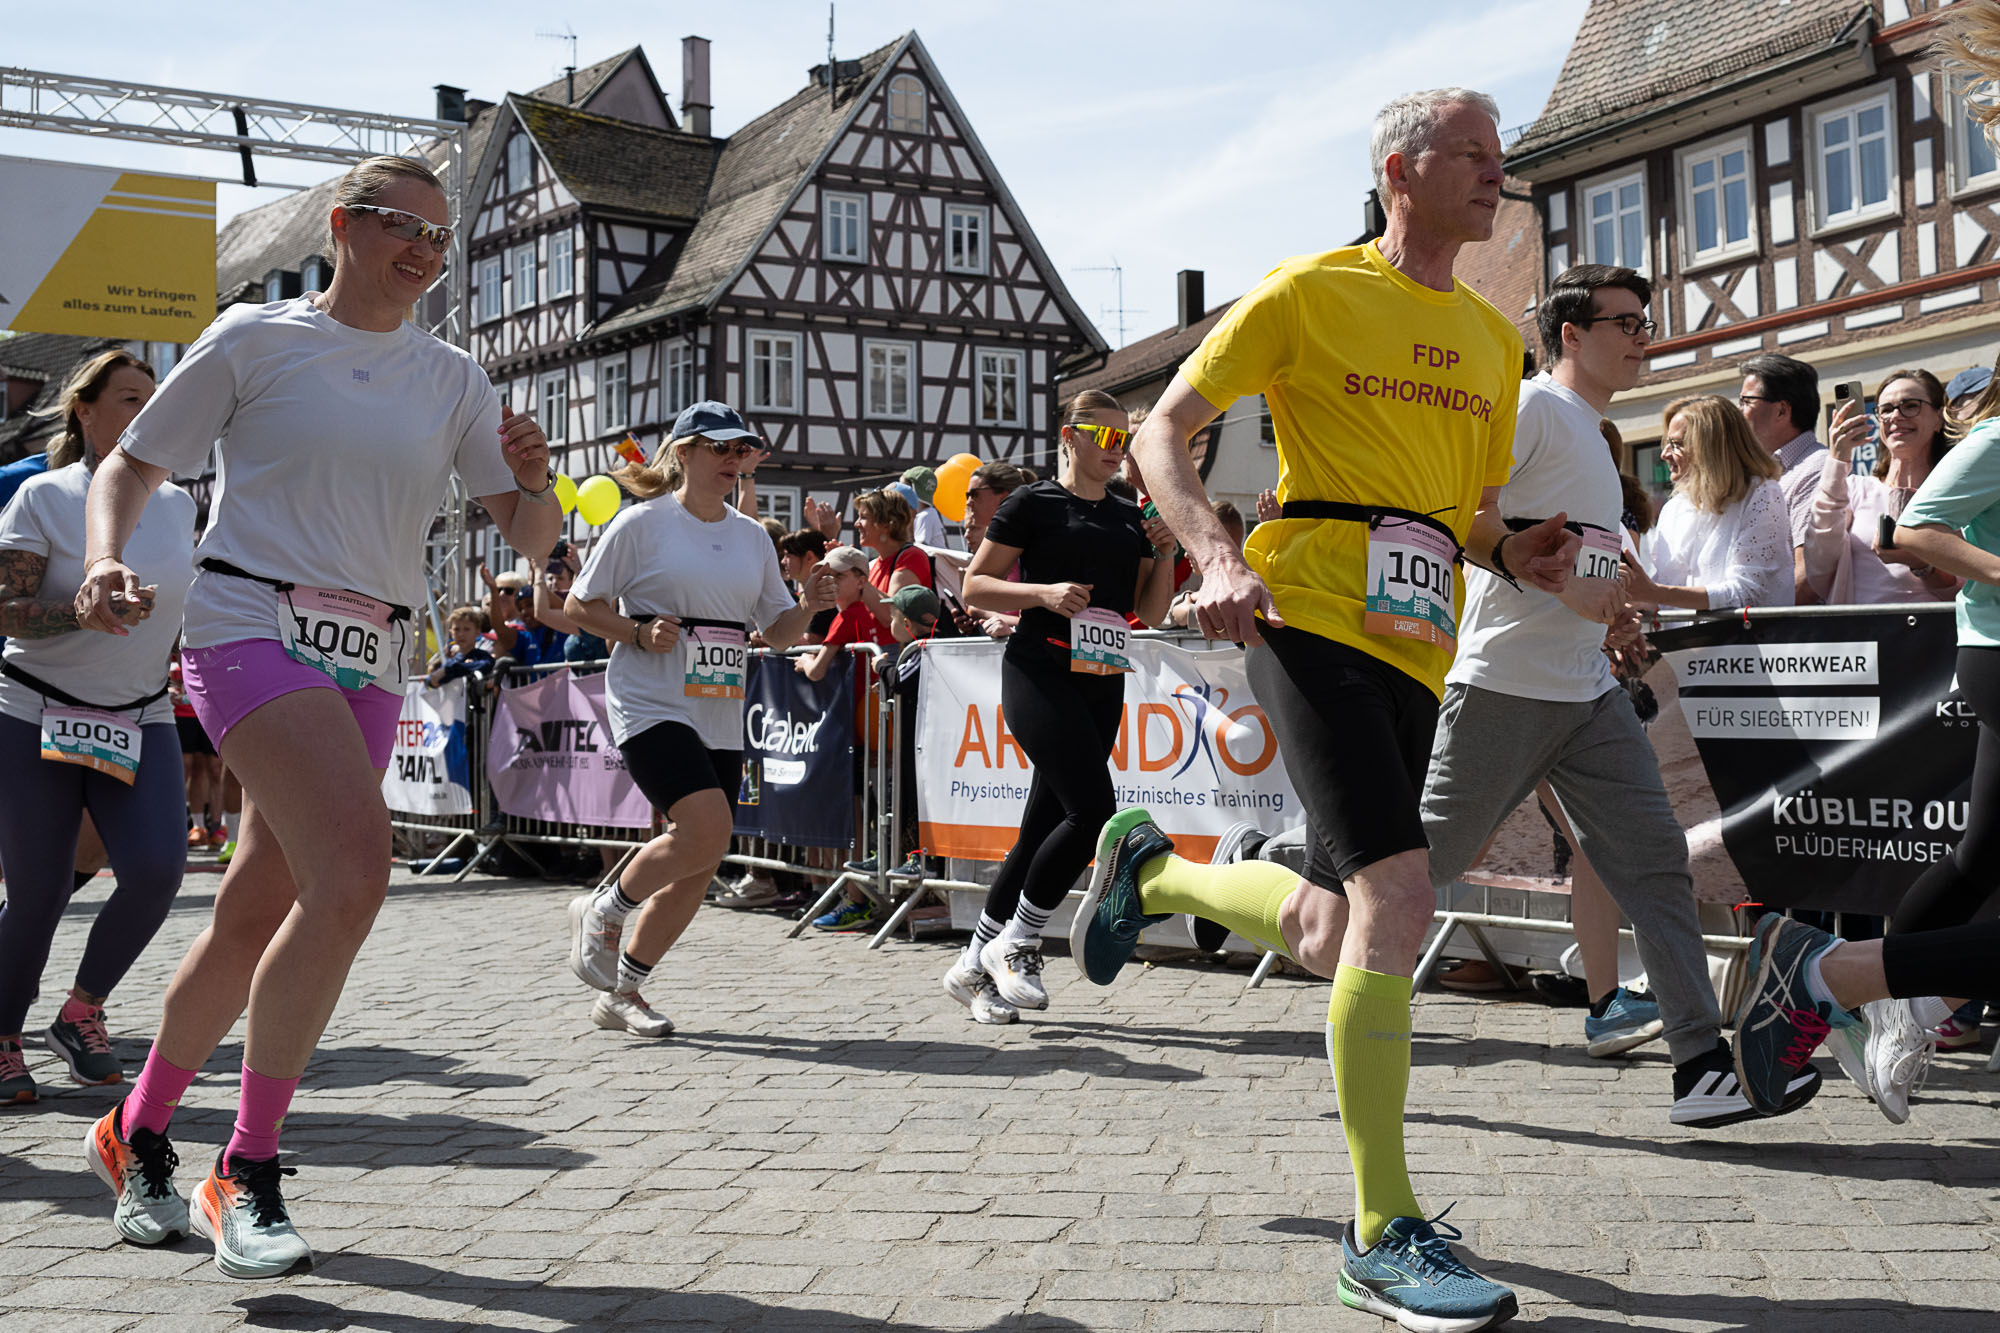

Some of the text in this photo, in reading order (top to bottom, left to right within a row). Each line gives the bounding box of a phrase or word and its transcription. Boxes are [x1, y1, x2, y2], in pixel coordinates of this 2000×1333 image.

[107, 285, 197, 302] Wir bringen
[63, 299, 197, 319] alles zum Laufen.
[1413, 343, 1460, 370] FDP
[1344, 373, 1492, 423] SCHORNDOR
[1388, 551, 1450, 603] 1010
[318, 591, 338, 600] RIANI
[294, 616, 378, 664] 1006
[1080, 624, 1125, 650] 1005
[697, 646, 743, 669] 1002
[1687, 656, 1867, 676] STARKE WORKWEAR
[1697, 706, 1870, 728] FÜR SIEGERTYPEN!
[56, 720, 129, 750] 1003
[395, 719, 425, 748] TER
[951, 780, 1284, 812] Physiother dizinisches Training
[1773, 790, 1969, 832] KÜBLER OU
